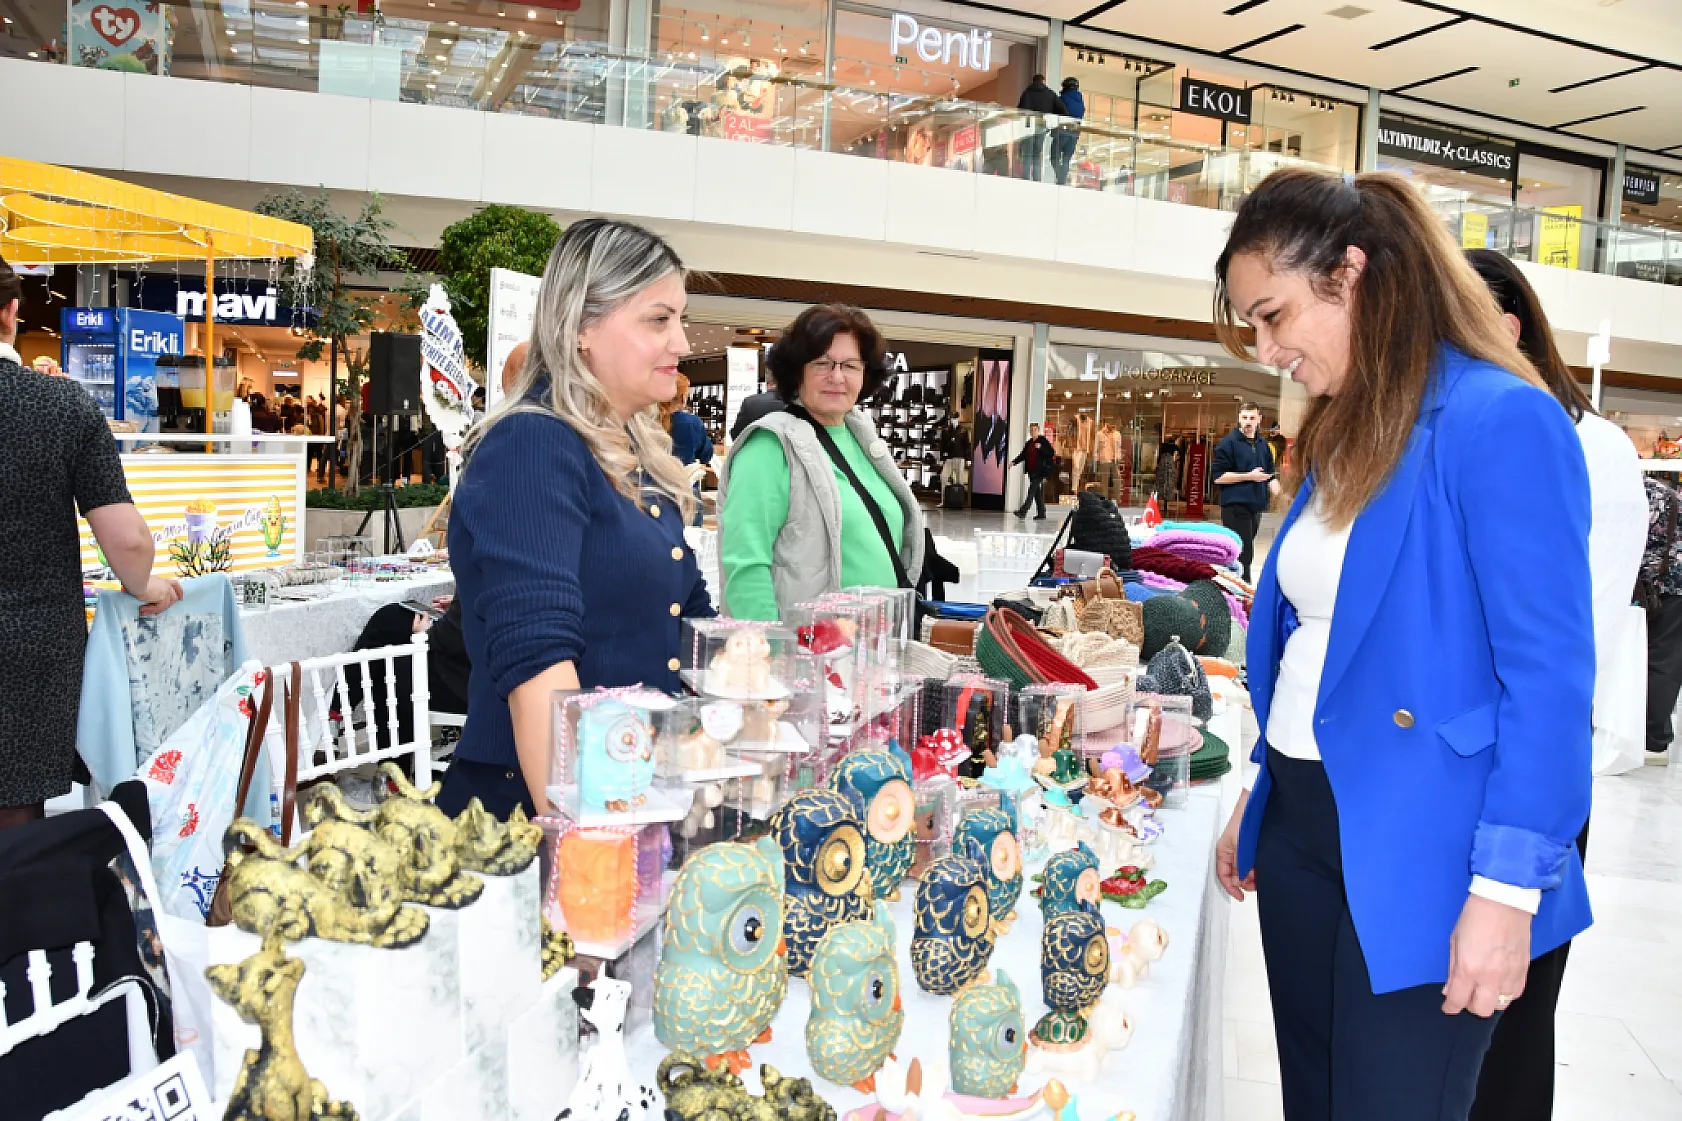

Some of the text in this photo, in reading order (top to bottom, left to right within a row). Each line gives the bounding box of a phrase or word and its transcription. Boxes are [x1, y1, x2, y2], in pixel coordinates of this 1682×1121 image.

[95, 8, 134, 40] ty
[890, 13, 992, 72] Penti
[1187, 84, 1248, 117] EKOL
[1457, 146, 1511, 169] CLASSICS
[76, 312, 104, 326] Erikli
[176, 287, 277, 321] mavi
